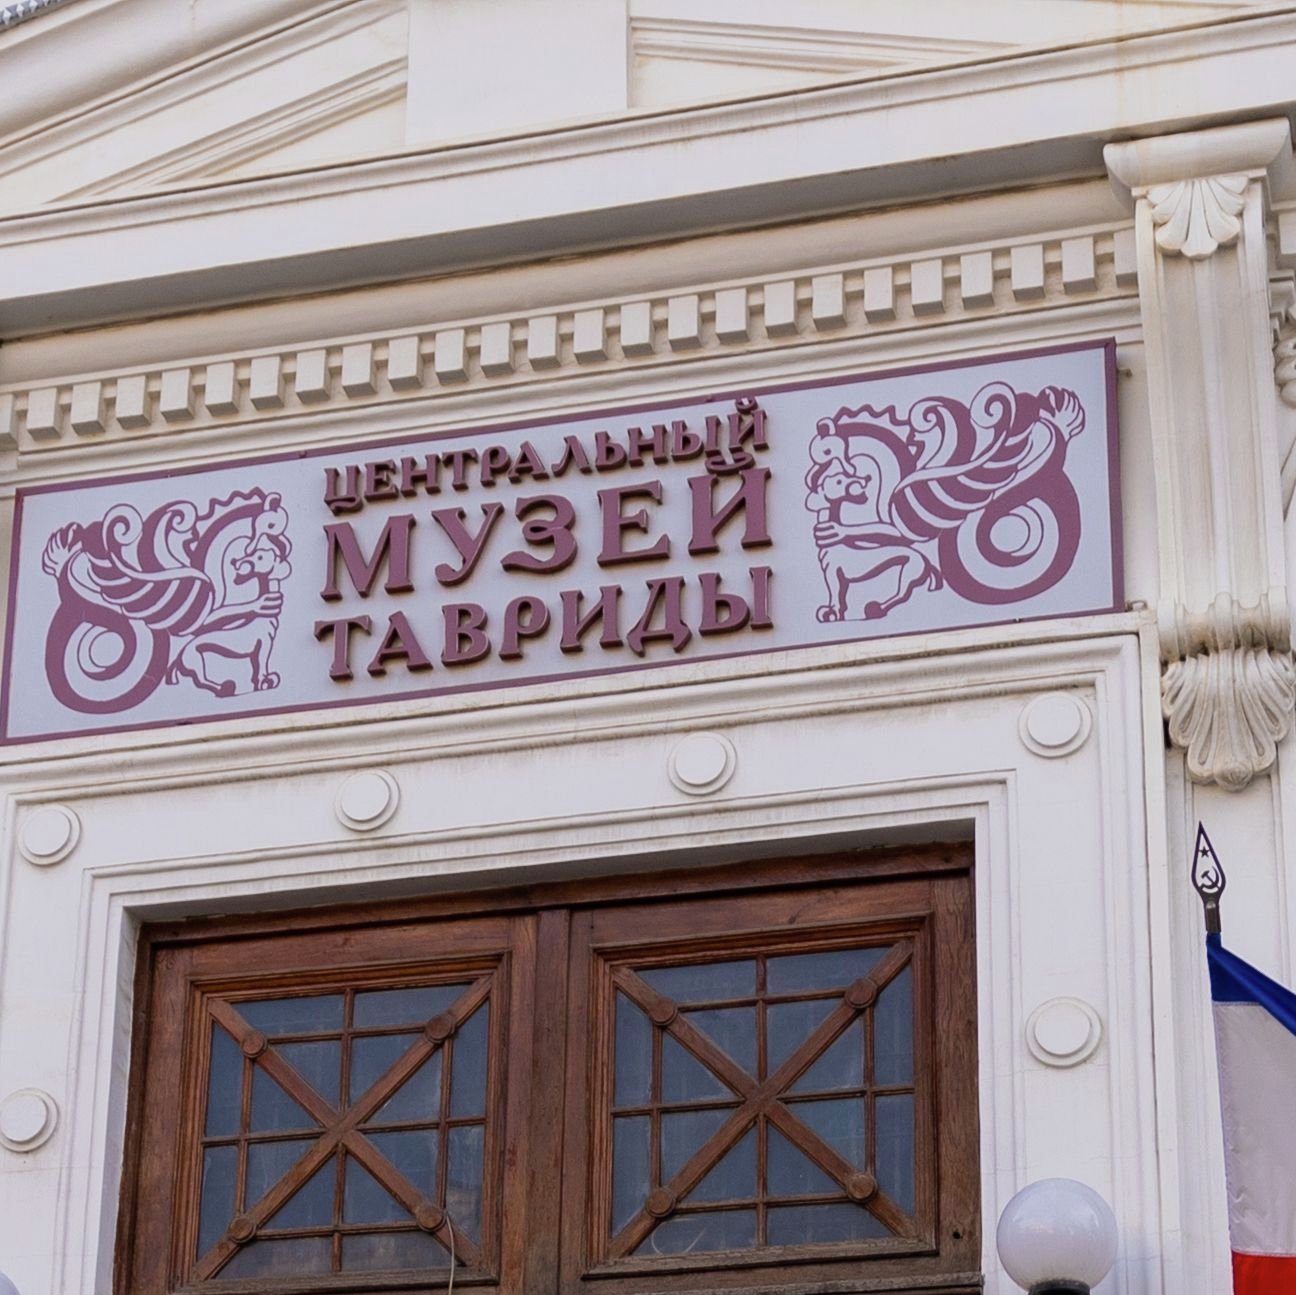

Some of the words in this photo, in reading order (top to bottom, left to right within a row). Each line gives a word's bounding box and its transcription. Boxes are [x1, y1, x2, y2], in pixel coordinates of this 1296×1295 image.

[323, 397, 769, 515] ЦЕНТРАЛЬНЫЙ
[319, 450, 773, 601] МУЗЕЙ
[314, 566, 773, 681] ТАВРИДЫ
